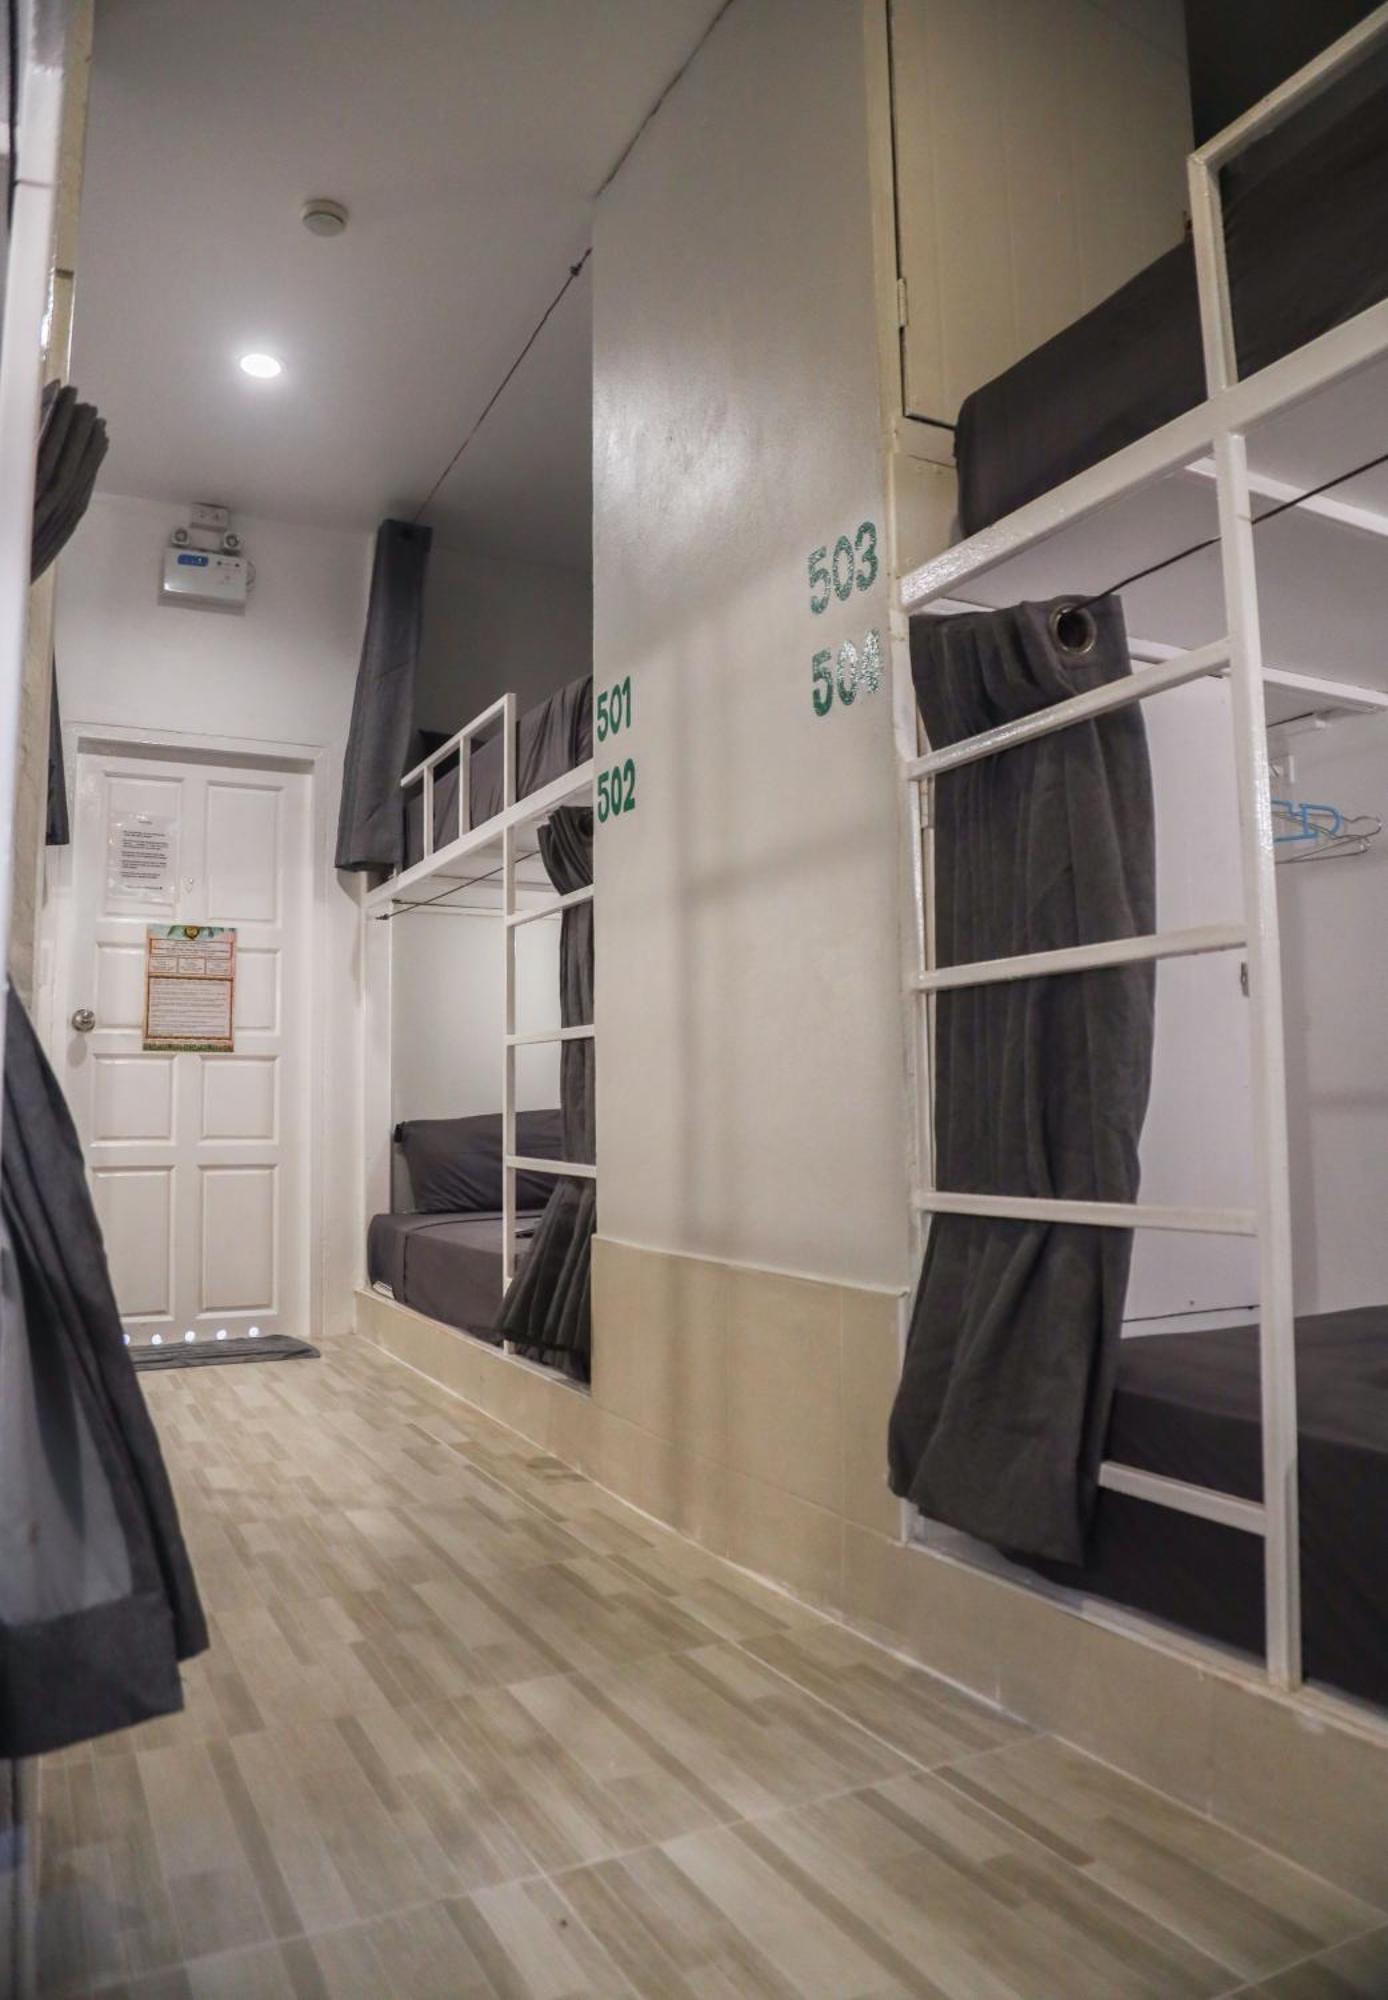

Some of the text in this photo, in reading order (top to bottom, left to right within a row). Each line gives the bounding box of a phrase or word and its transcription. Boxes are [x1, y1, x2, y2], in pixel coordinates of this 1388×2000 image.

[809, 522, 878, 614] 503
[597, 676, 631, 742] 501
[813, 628, 881, 716] 504
[598, 758, 635, 823] 502
